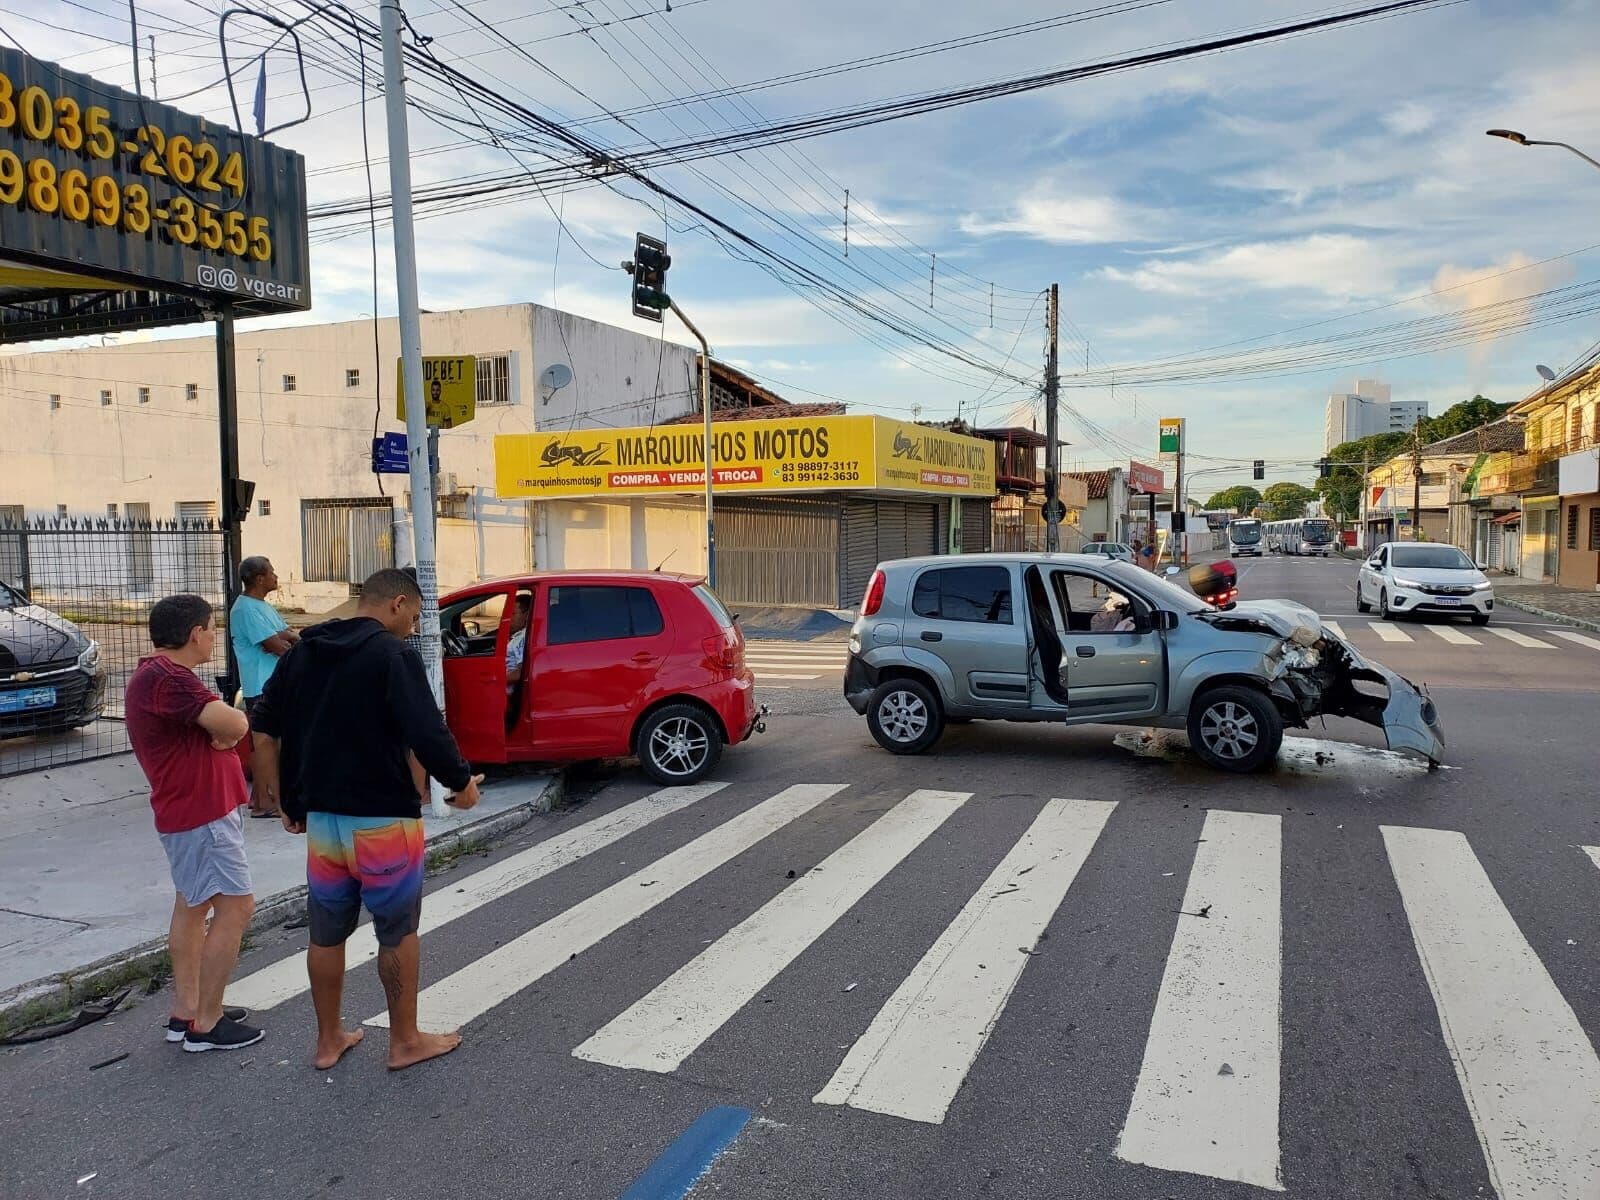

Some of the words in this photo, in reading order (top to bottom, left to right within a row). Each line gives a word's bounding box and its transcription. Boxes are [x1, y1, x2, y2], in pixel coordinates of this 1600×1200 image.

[0, 150, 271, 261] 98693-3555
[243, 277, 301, 300] vgcarr
[617, 431, 746, 466] MARQUINHOS
[754, 427, 829, 460] MOTOS
[782, 463, 794, 471] 83
[798, 461, 858, 471] 98897-3117
[525, 475, 602, 489] marquinhosmotosjp
[612, 473, 659, 485] COMPRA
[669, 472, 705, 484] VENDA
[717, 470, 757, 481] TROCA
[782, 473, 794, 482] 83
[798, 472, 859, 481] 99142-3630
